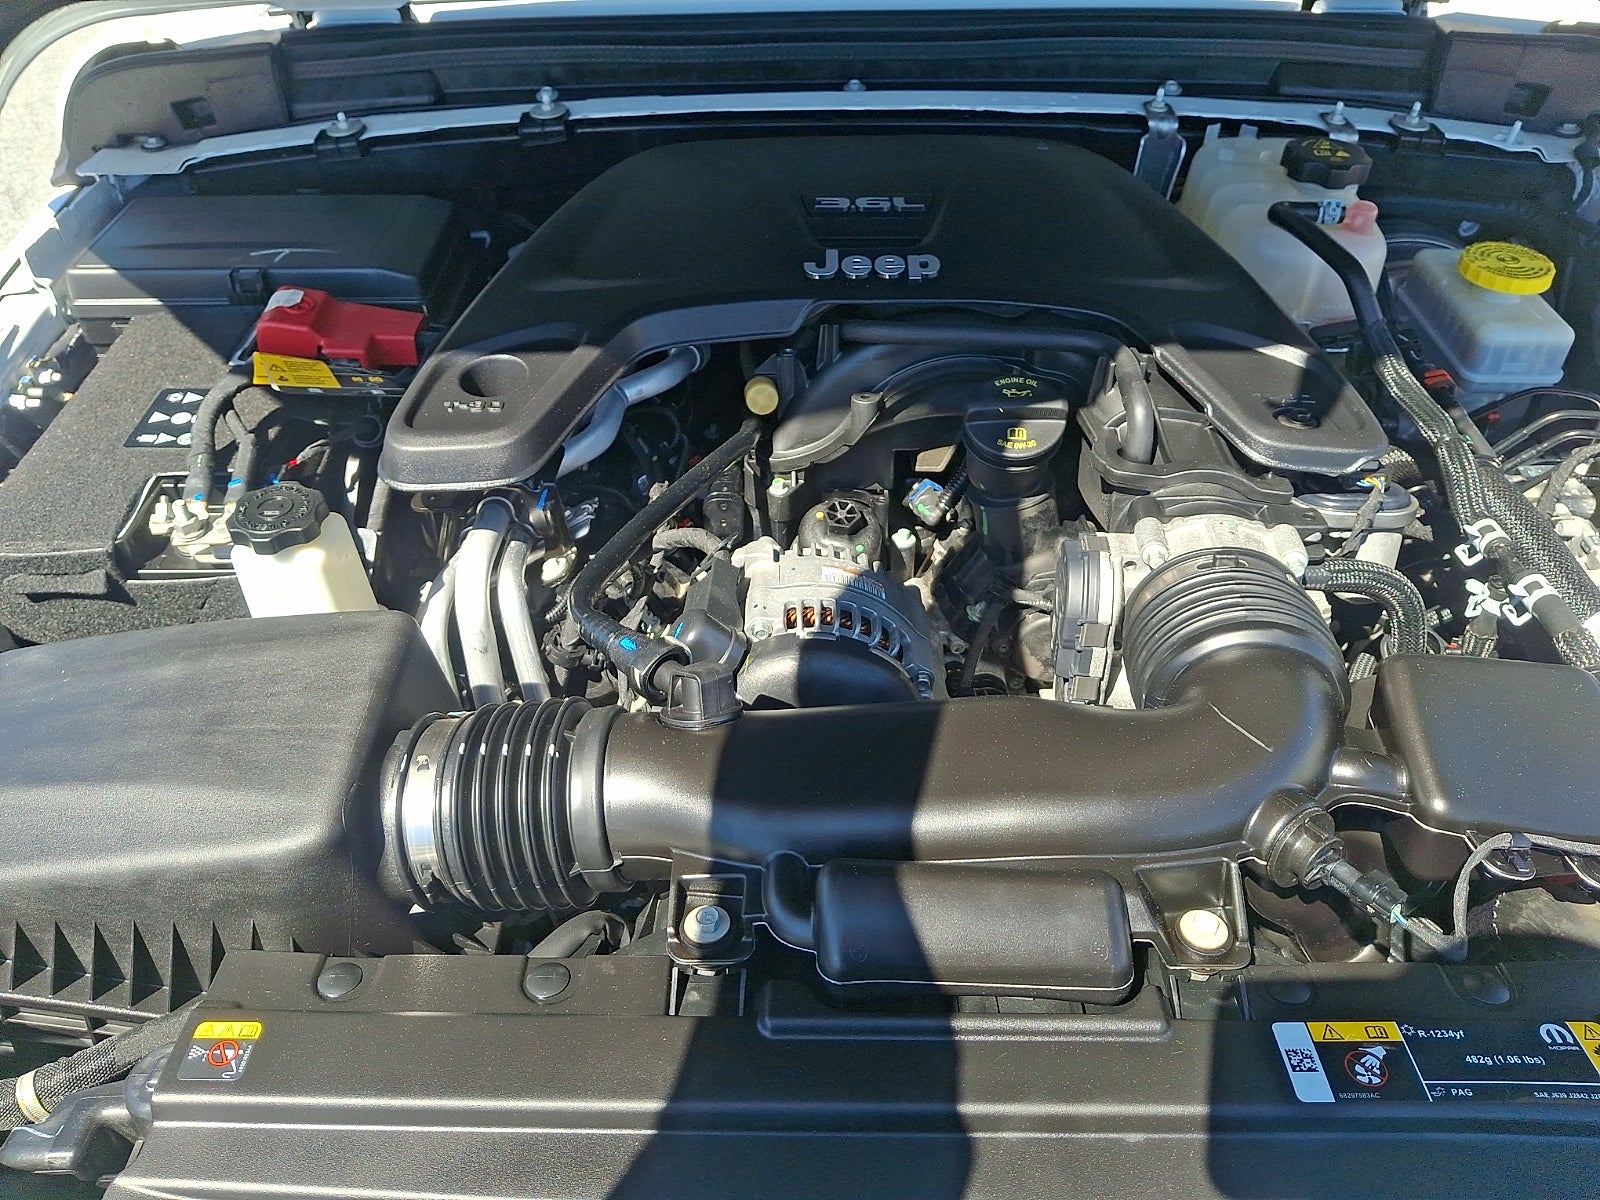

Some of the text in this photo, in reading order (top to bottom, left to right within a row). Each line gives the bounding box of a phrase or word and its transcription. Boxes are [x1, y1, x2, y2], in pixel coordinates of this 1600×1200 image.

[814, 196, 925, 212] 3.6L
[803, 249, 941, 282] Jeep
[994, 376, 1038, 387] ENGINE OIL
[996, 438, 1013, 449] SAE
[1418, 1029, 1465, 1039] R-1234yf
[1465, 1055, 1546, 1065] 482g (1.06 lbs)
[1450, 1088, 1474, 1097] PAG
